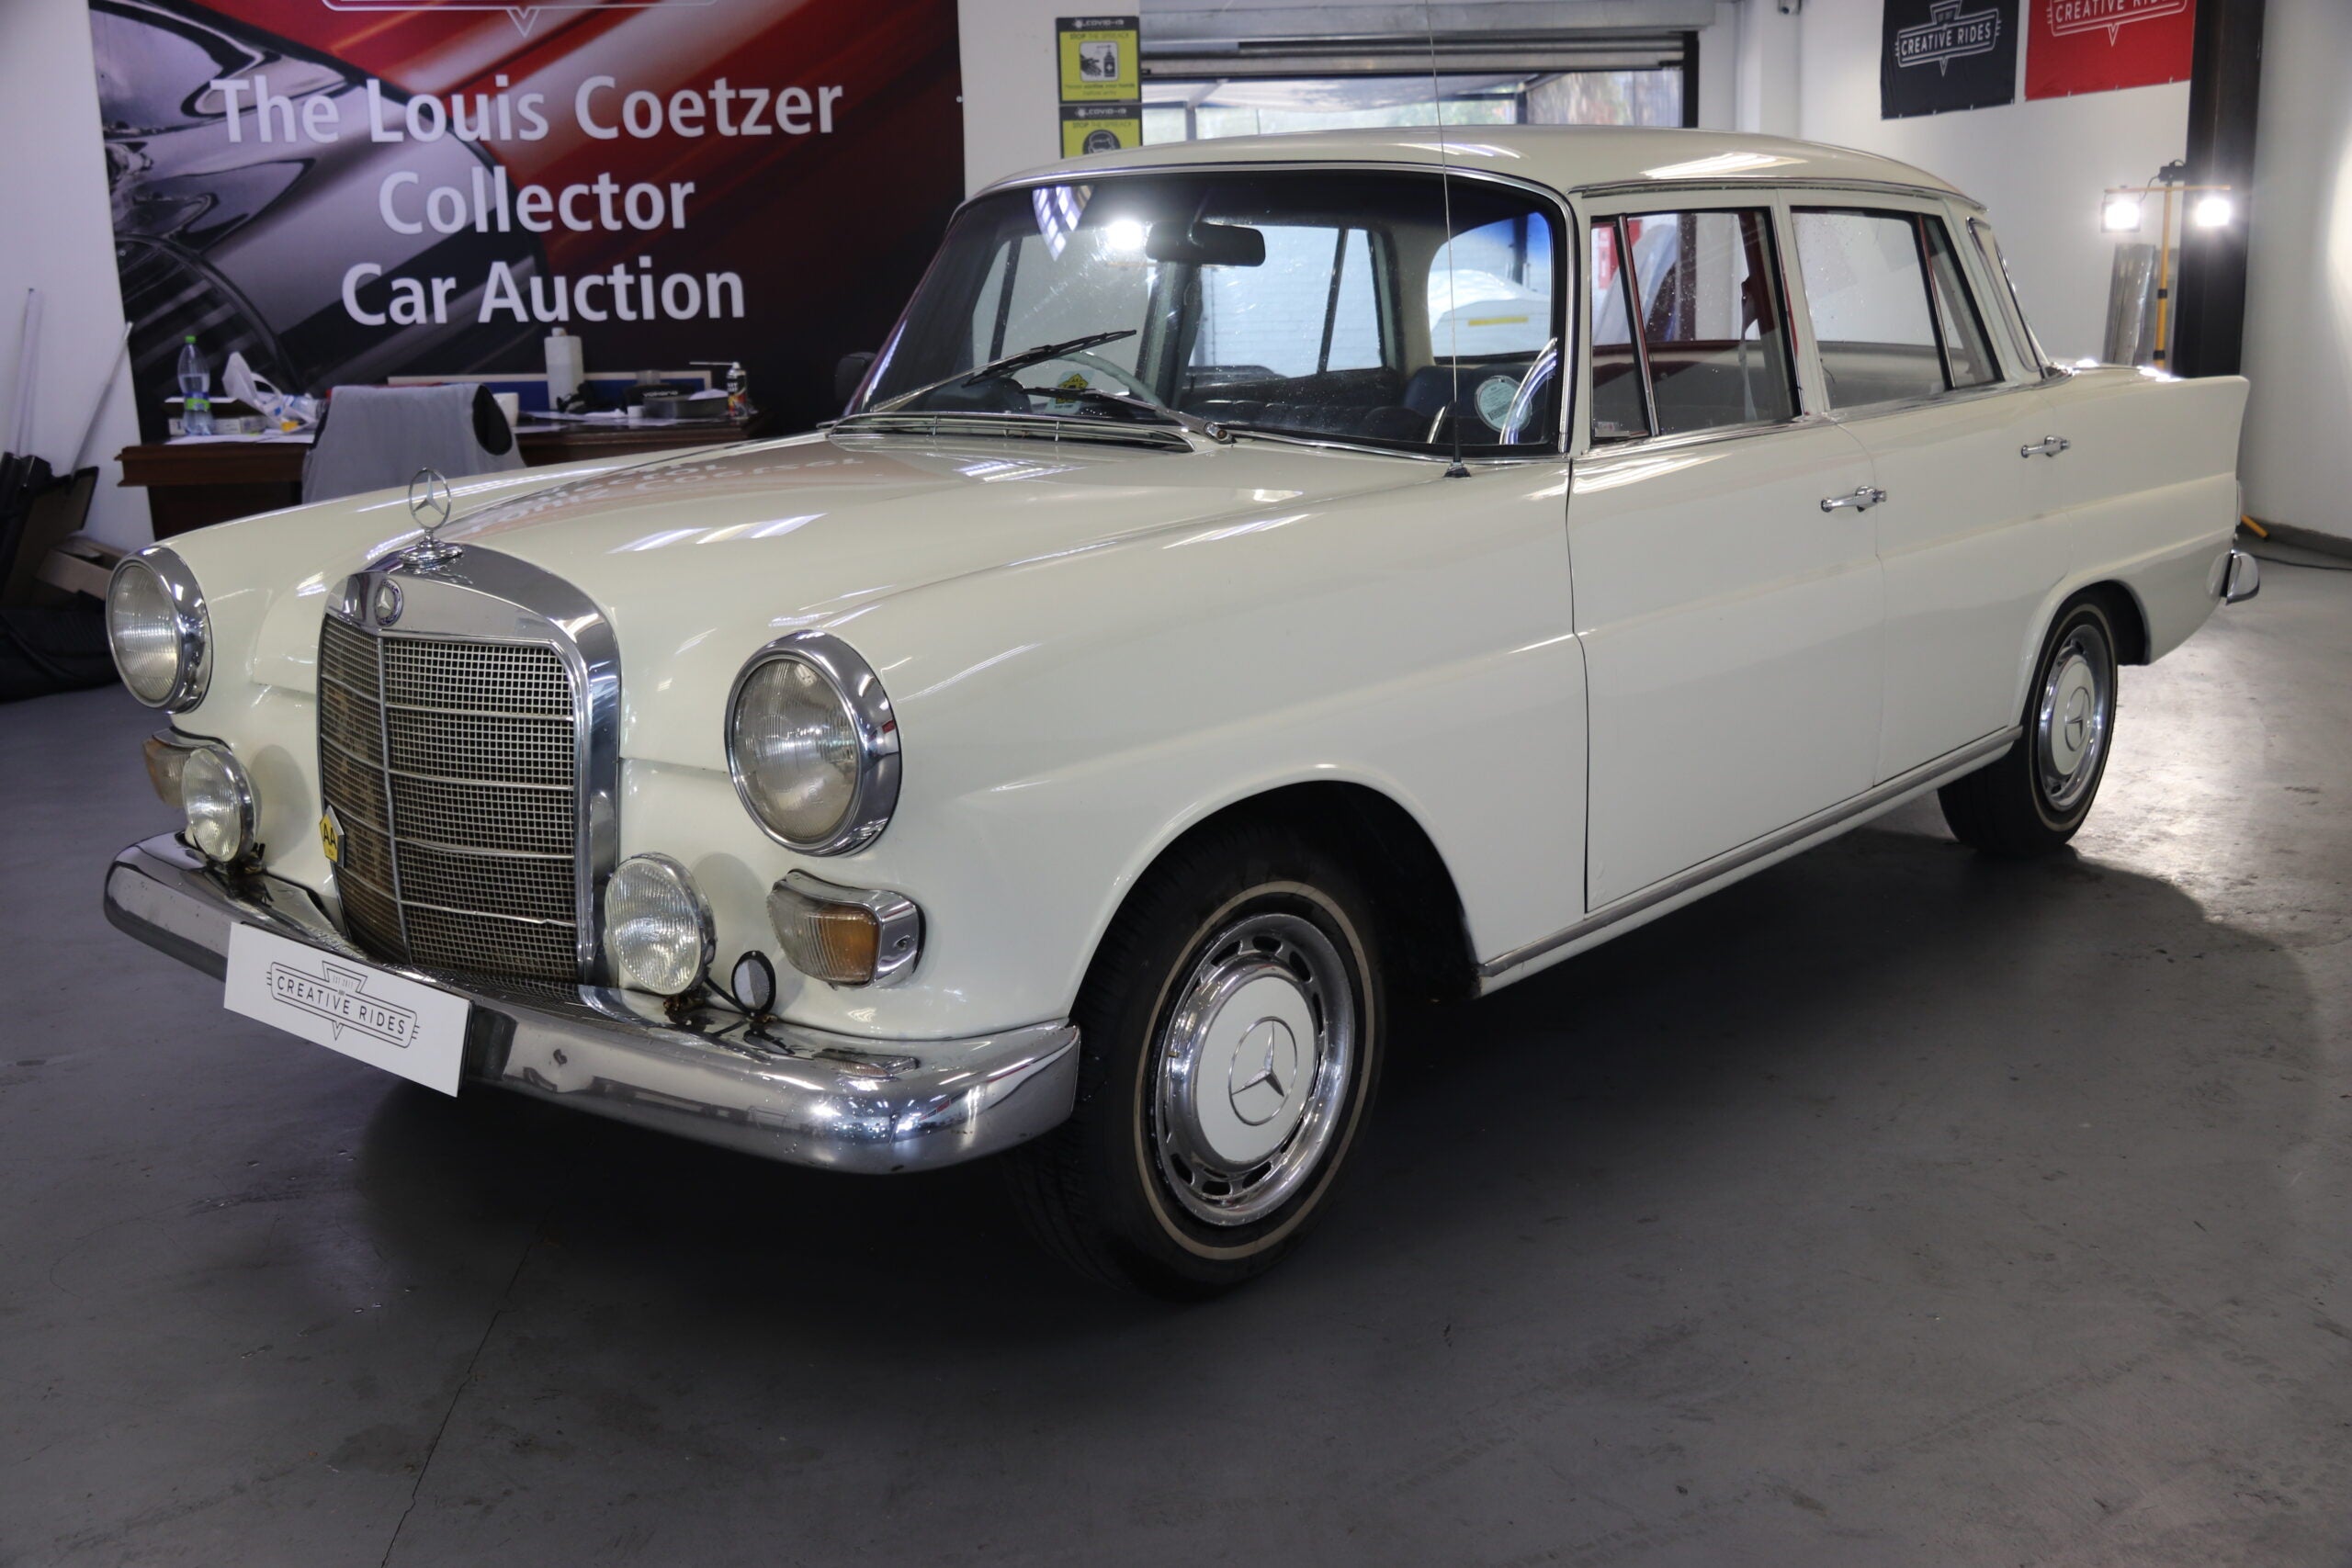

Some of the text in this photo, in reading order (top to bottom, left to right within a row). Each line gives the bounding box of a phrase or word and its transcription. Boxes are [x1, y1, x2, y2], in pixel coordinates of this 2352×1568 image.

[1901, 22, 1991, 55] CREATIVE RIDES
[2055, 0, 2125, 23] CREATIVE
[210, 74, 843, 142] The Louis Coetzer
[379, 165, 695, 234] Collector
[341, 255, 745, 325] Car Auction
[322, 822, 337, 850] AA
[277, 976, 405, 1034] CREATIVE RIDES
